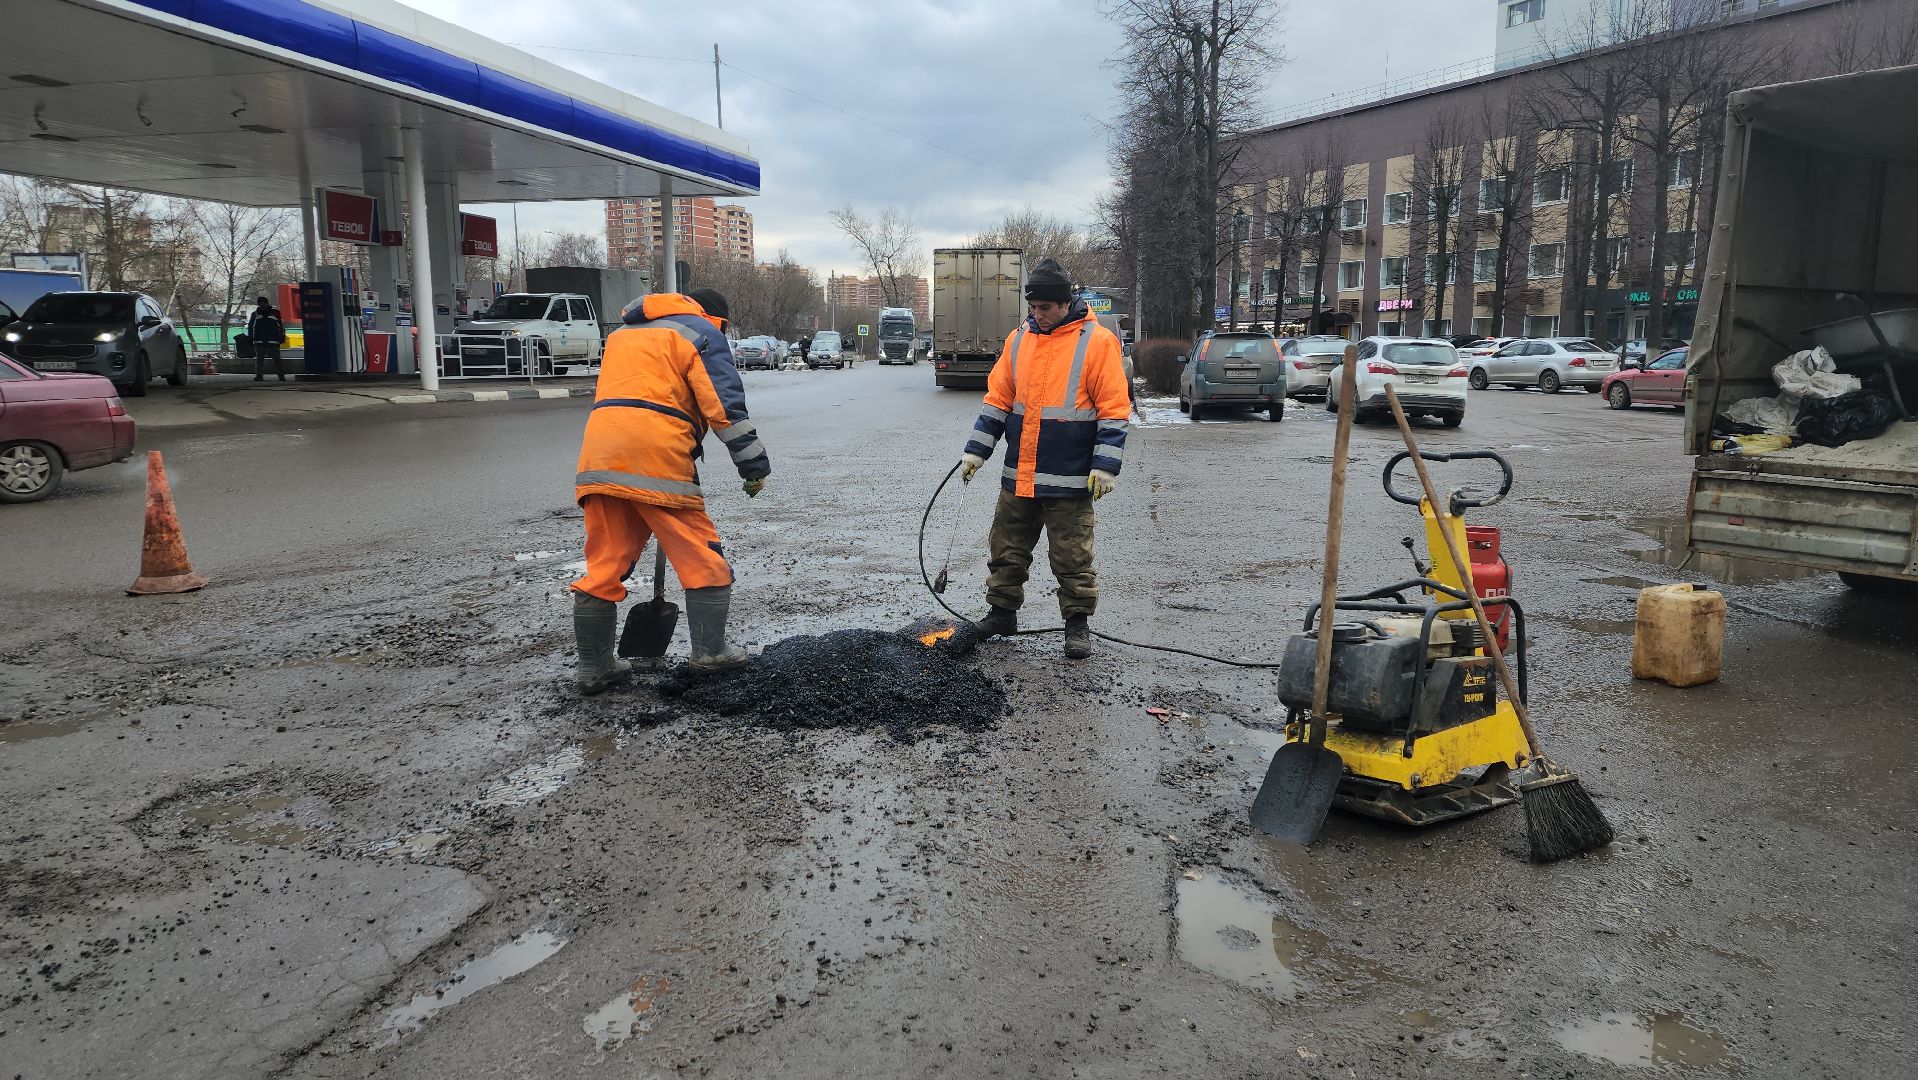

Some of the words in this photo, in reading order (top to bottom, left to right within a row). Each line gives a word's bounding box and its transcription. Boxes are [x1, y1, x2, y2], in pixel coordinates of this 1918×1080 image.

[331, 220, 366, 235] TEBOIL
[1378, 299, 1413, 312] ДВЕРИ
[374, 353, 380, 364] 3
